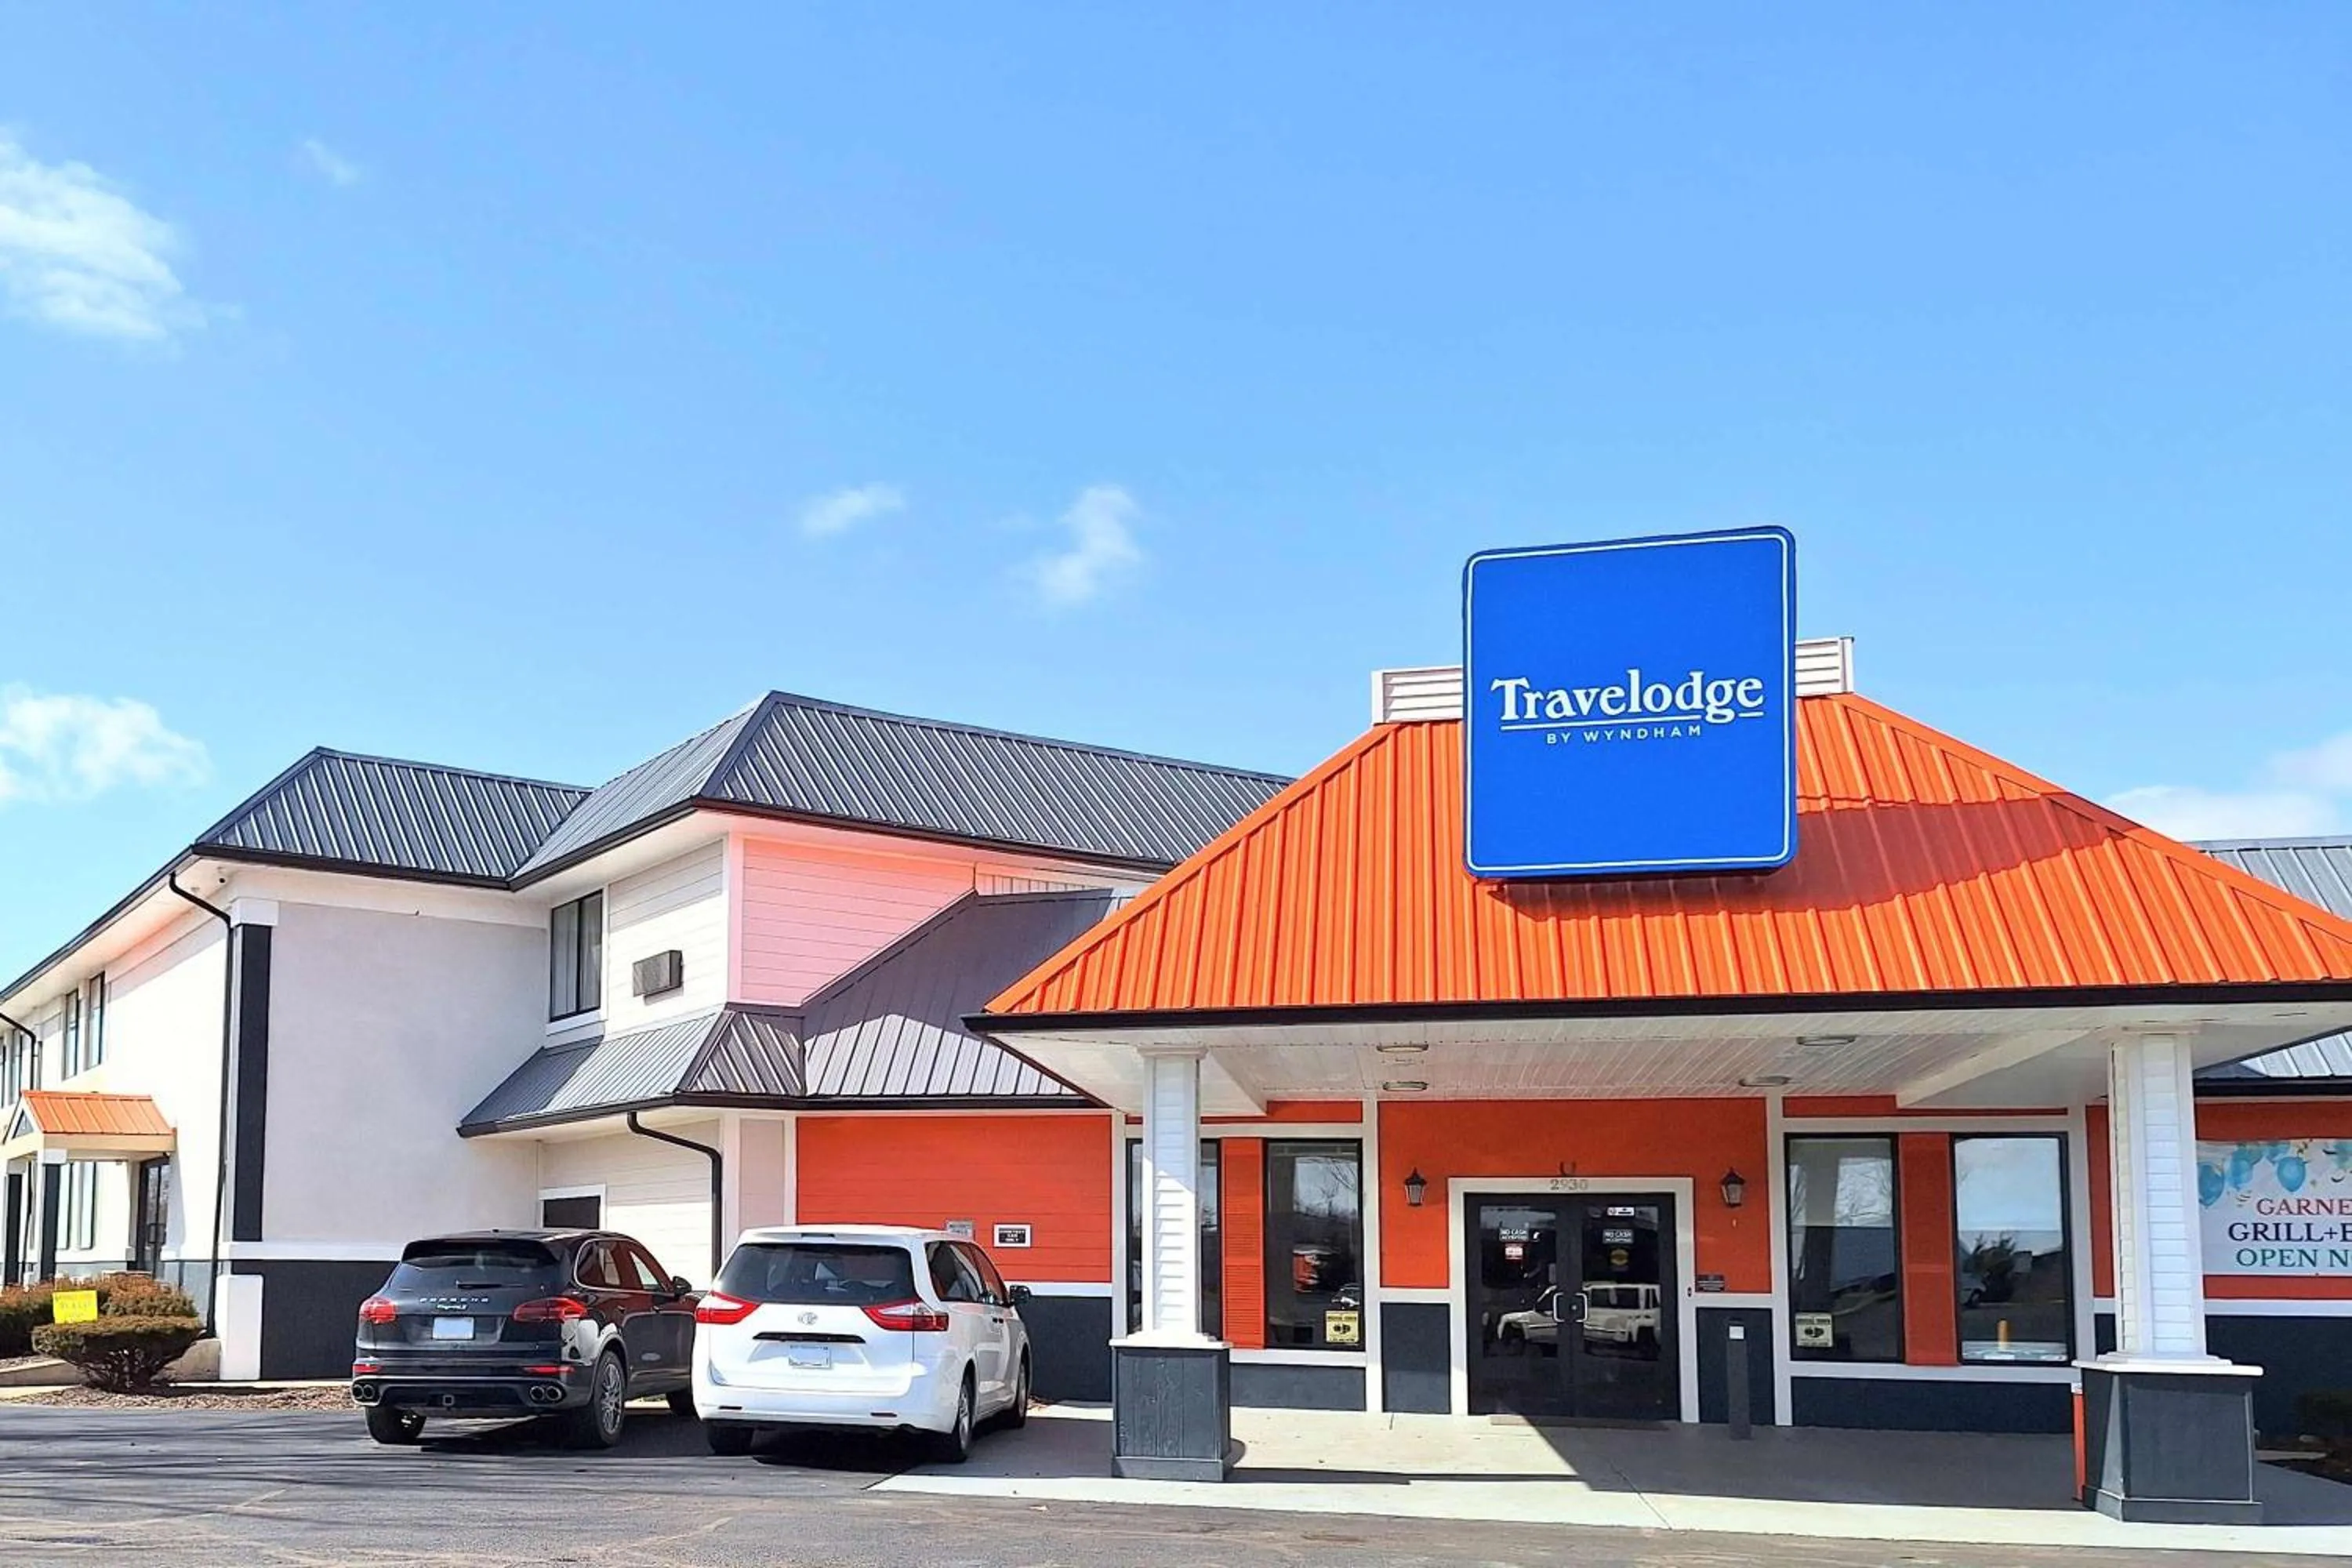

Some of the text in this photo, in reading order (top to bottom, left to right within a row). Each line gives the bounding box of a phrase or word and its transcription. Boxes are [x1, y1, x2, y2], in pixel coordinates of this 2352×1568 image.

[1491, 669, 1764, 724] Travelodge
[1547, 725, 1701, 744] BY WYNDHAM
[2236, 1248, 2318, 1268] OPEN
